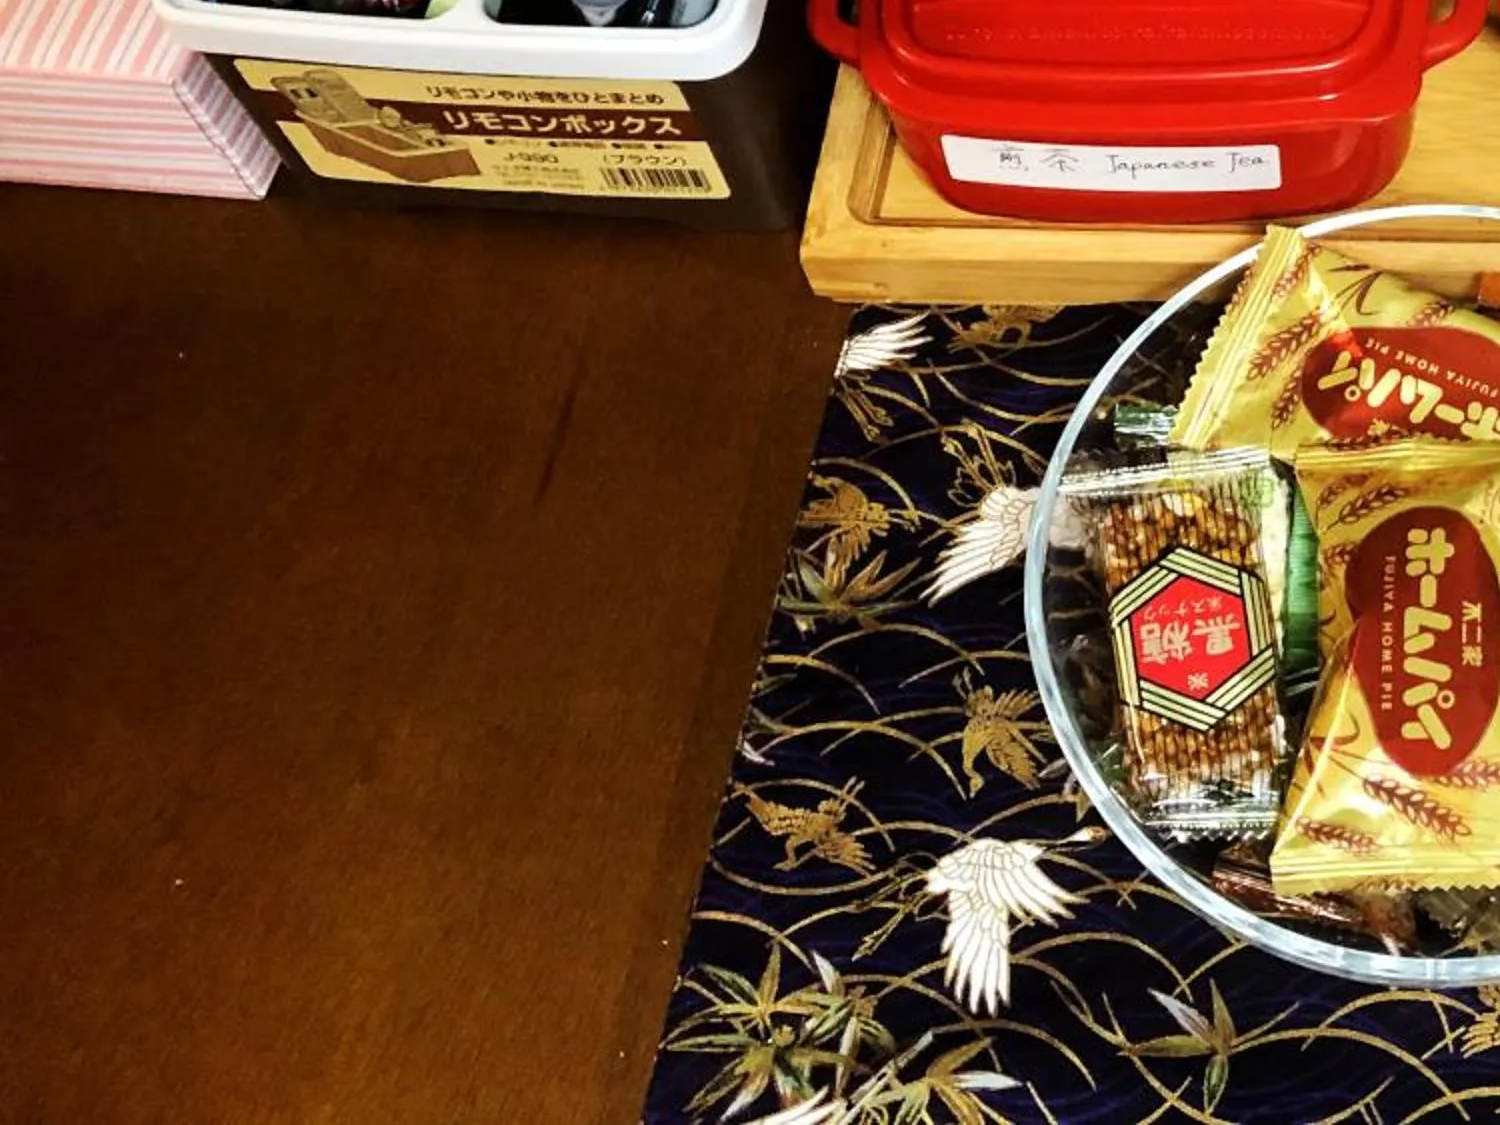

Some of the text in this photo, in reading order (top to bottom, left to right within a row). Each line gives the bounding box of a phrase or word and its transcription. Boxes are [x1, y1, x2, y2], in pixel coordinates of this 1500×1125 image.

[443, 110, 682, 136] リモコンボックス
[1105, 152, 1216, 179] Japanese
[1364, 337, 1500, 399] FUJIYA HOME PIE
[1142, 595, 1225, 619] 米スナック
[1380, 555, 1397, 711] FUJIYA HOME PIE
[1461, 600, 1483, 667] 不二家
[1138, 612, 1243, 666] 黒糖
[1400, 526, 1456, 751] ホームパイ
